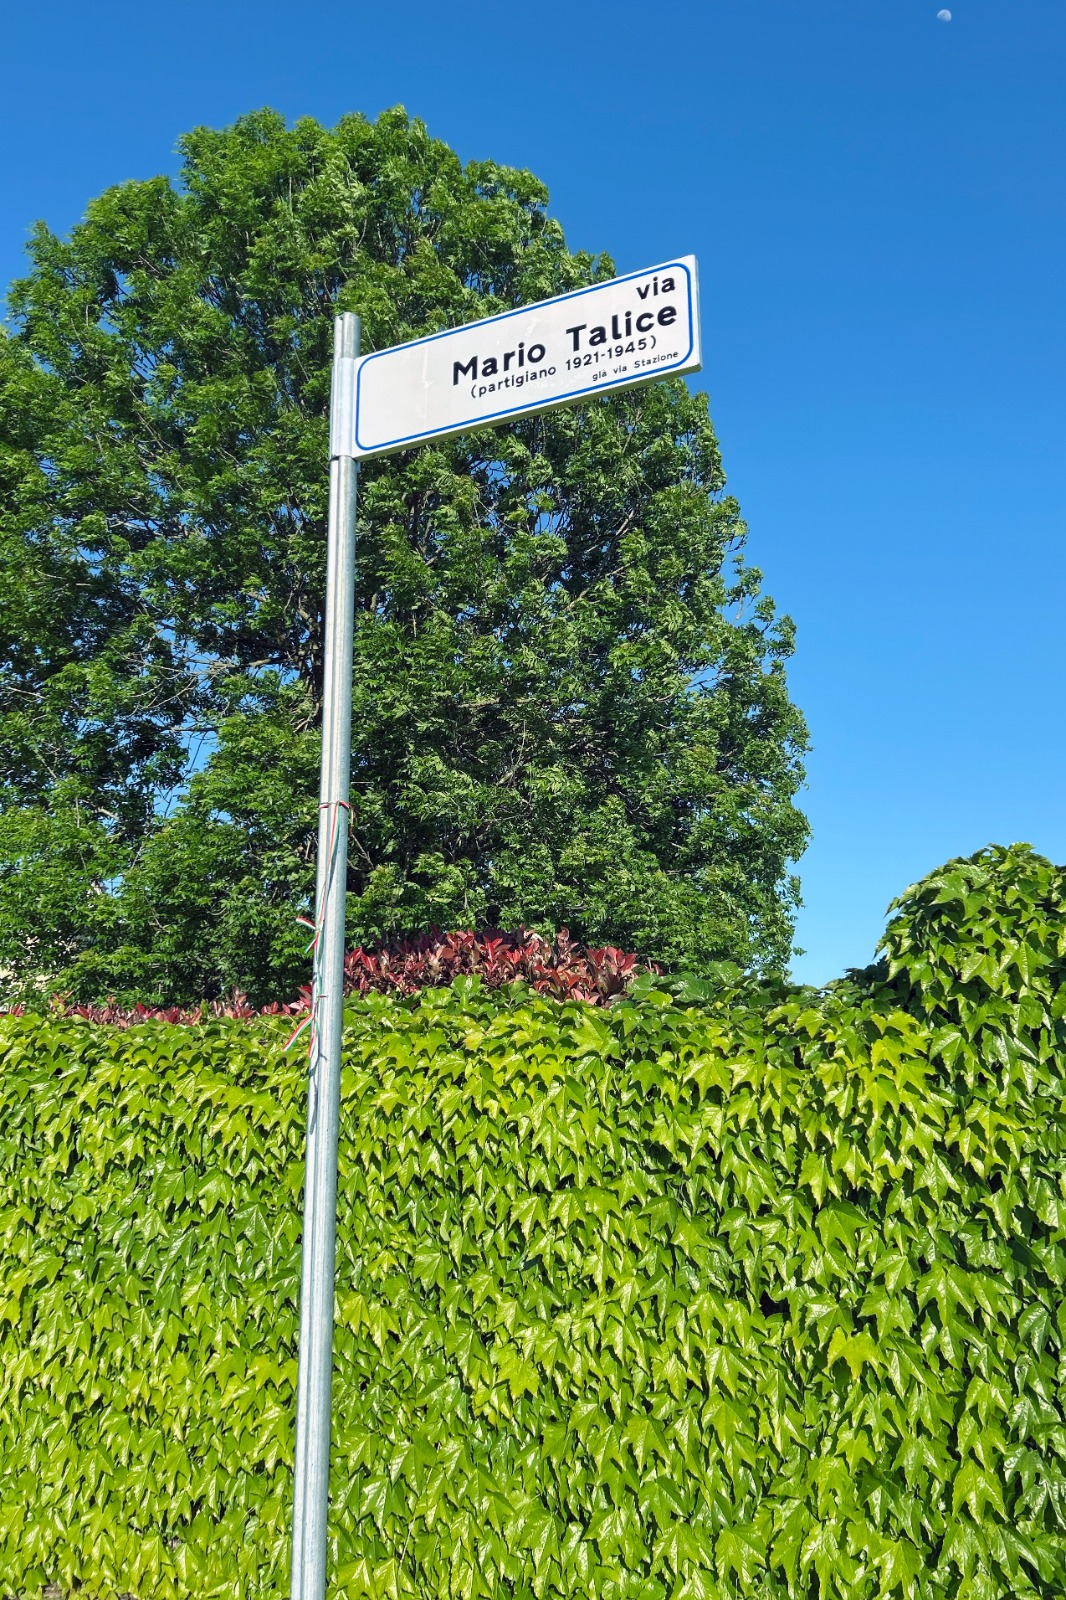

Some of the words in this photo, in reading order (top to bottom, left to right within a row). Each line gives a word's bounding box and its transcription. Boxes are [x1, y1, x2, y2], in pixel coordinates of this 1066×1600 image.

[636, 276, 676, 300] via
[452, 341, 546, 386] Mario
[566, 305, 677, 352] Talice
[470, 366, 557, 399] (partigiano
[565, 334, 657, 371] 1921-1945)
[613, 365, 627, 374] via
[634, 351, 679, 369] Stazione
